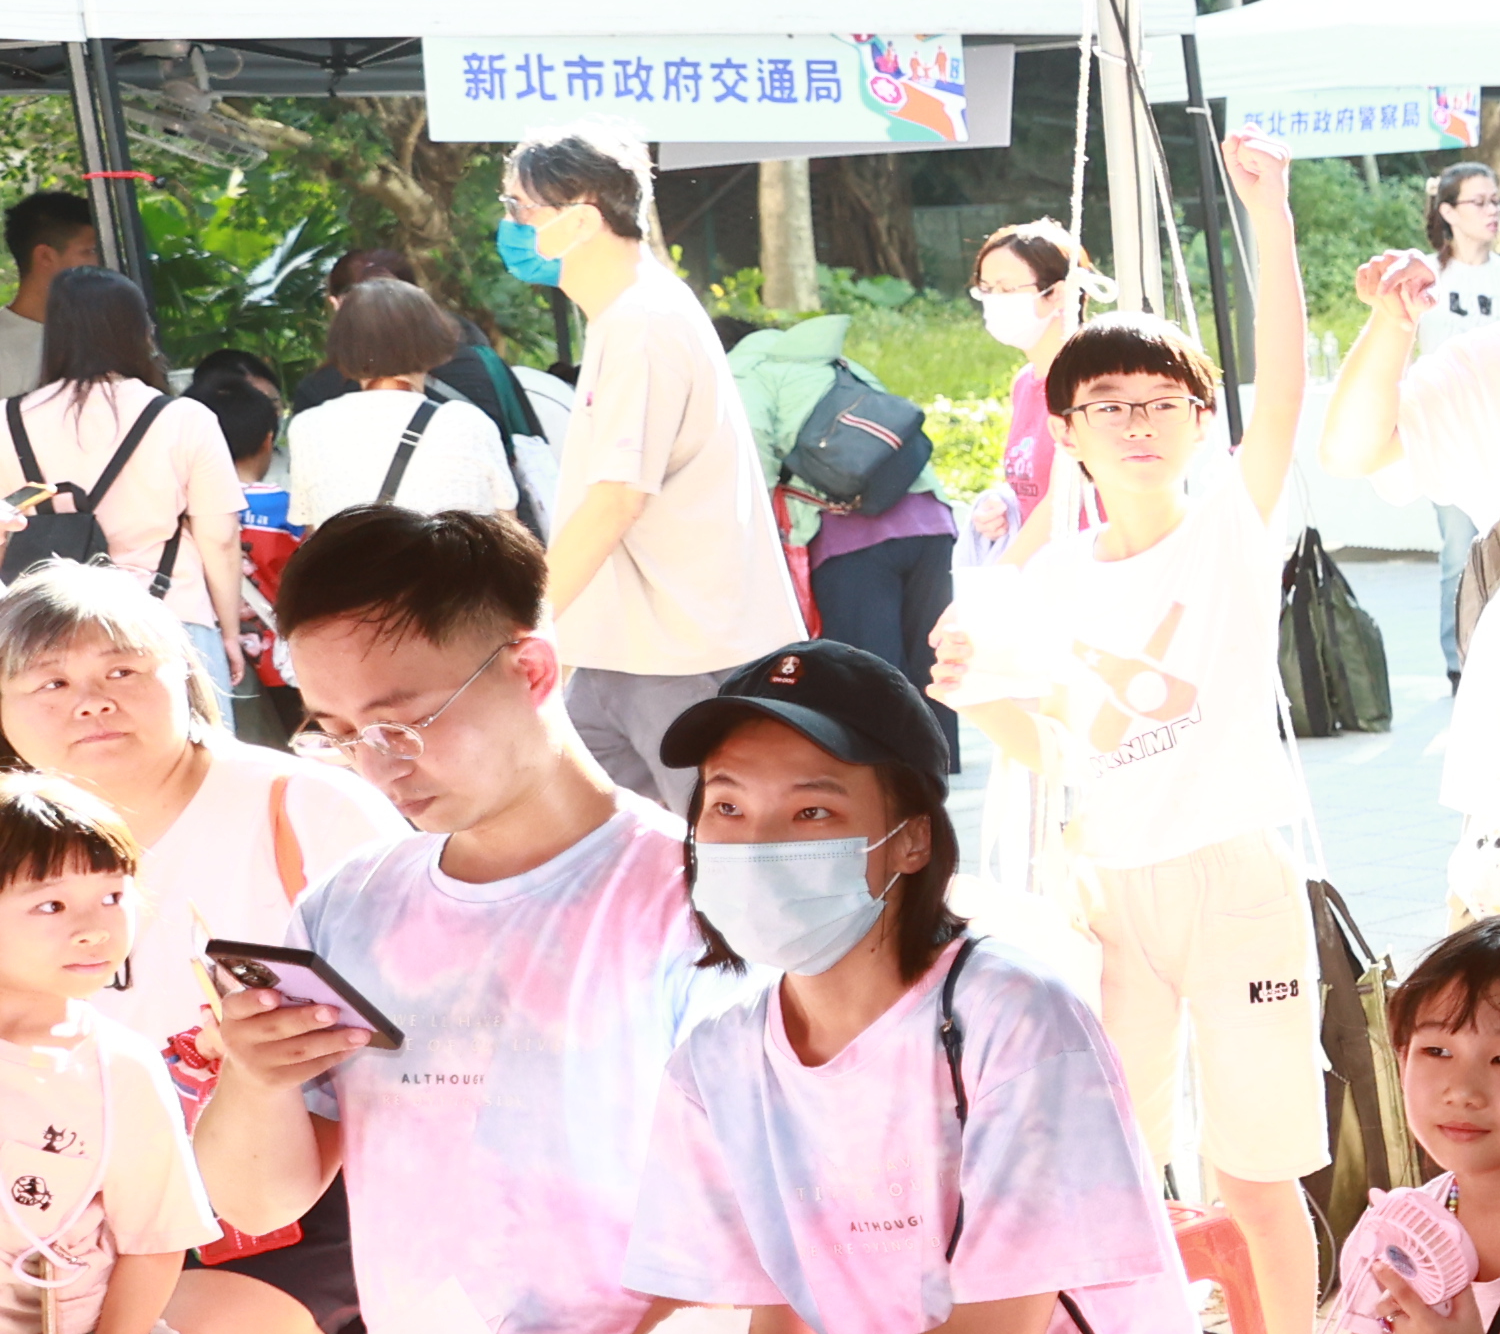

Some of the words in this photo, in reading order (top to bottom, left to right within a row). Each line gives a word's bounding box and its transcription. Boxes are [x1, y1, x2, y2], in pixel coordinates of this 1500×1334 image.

[462, 53, 842, 103] 新北市政府交通局
